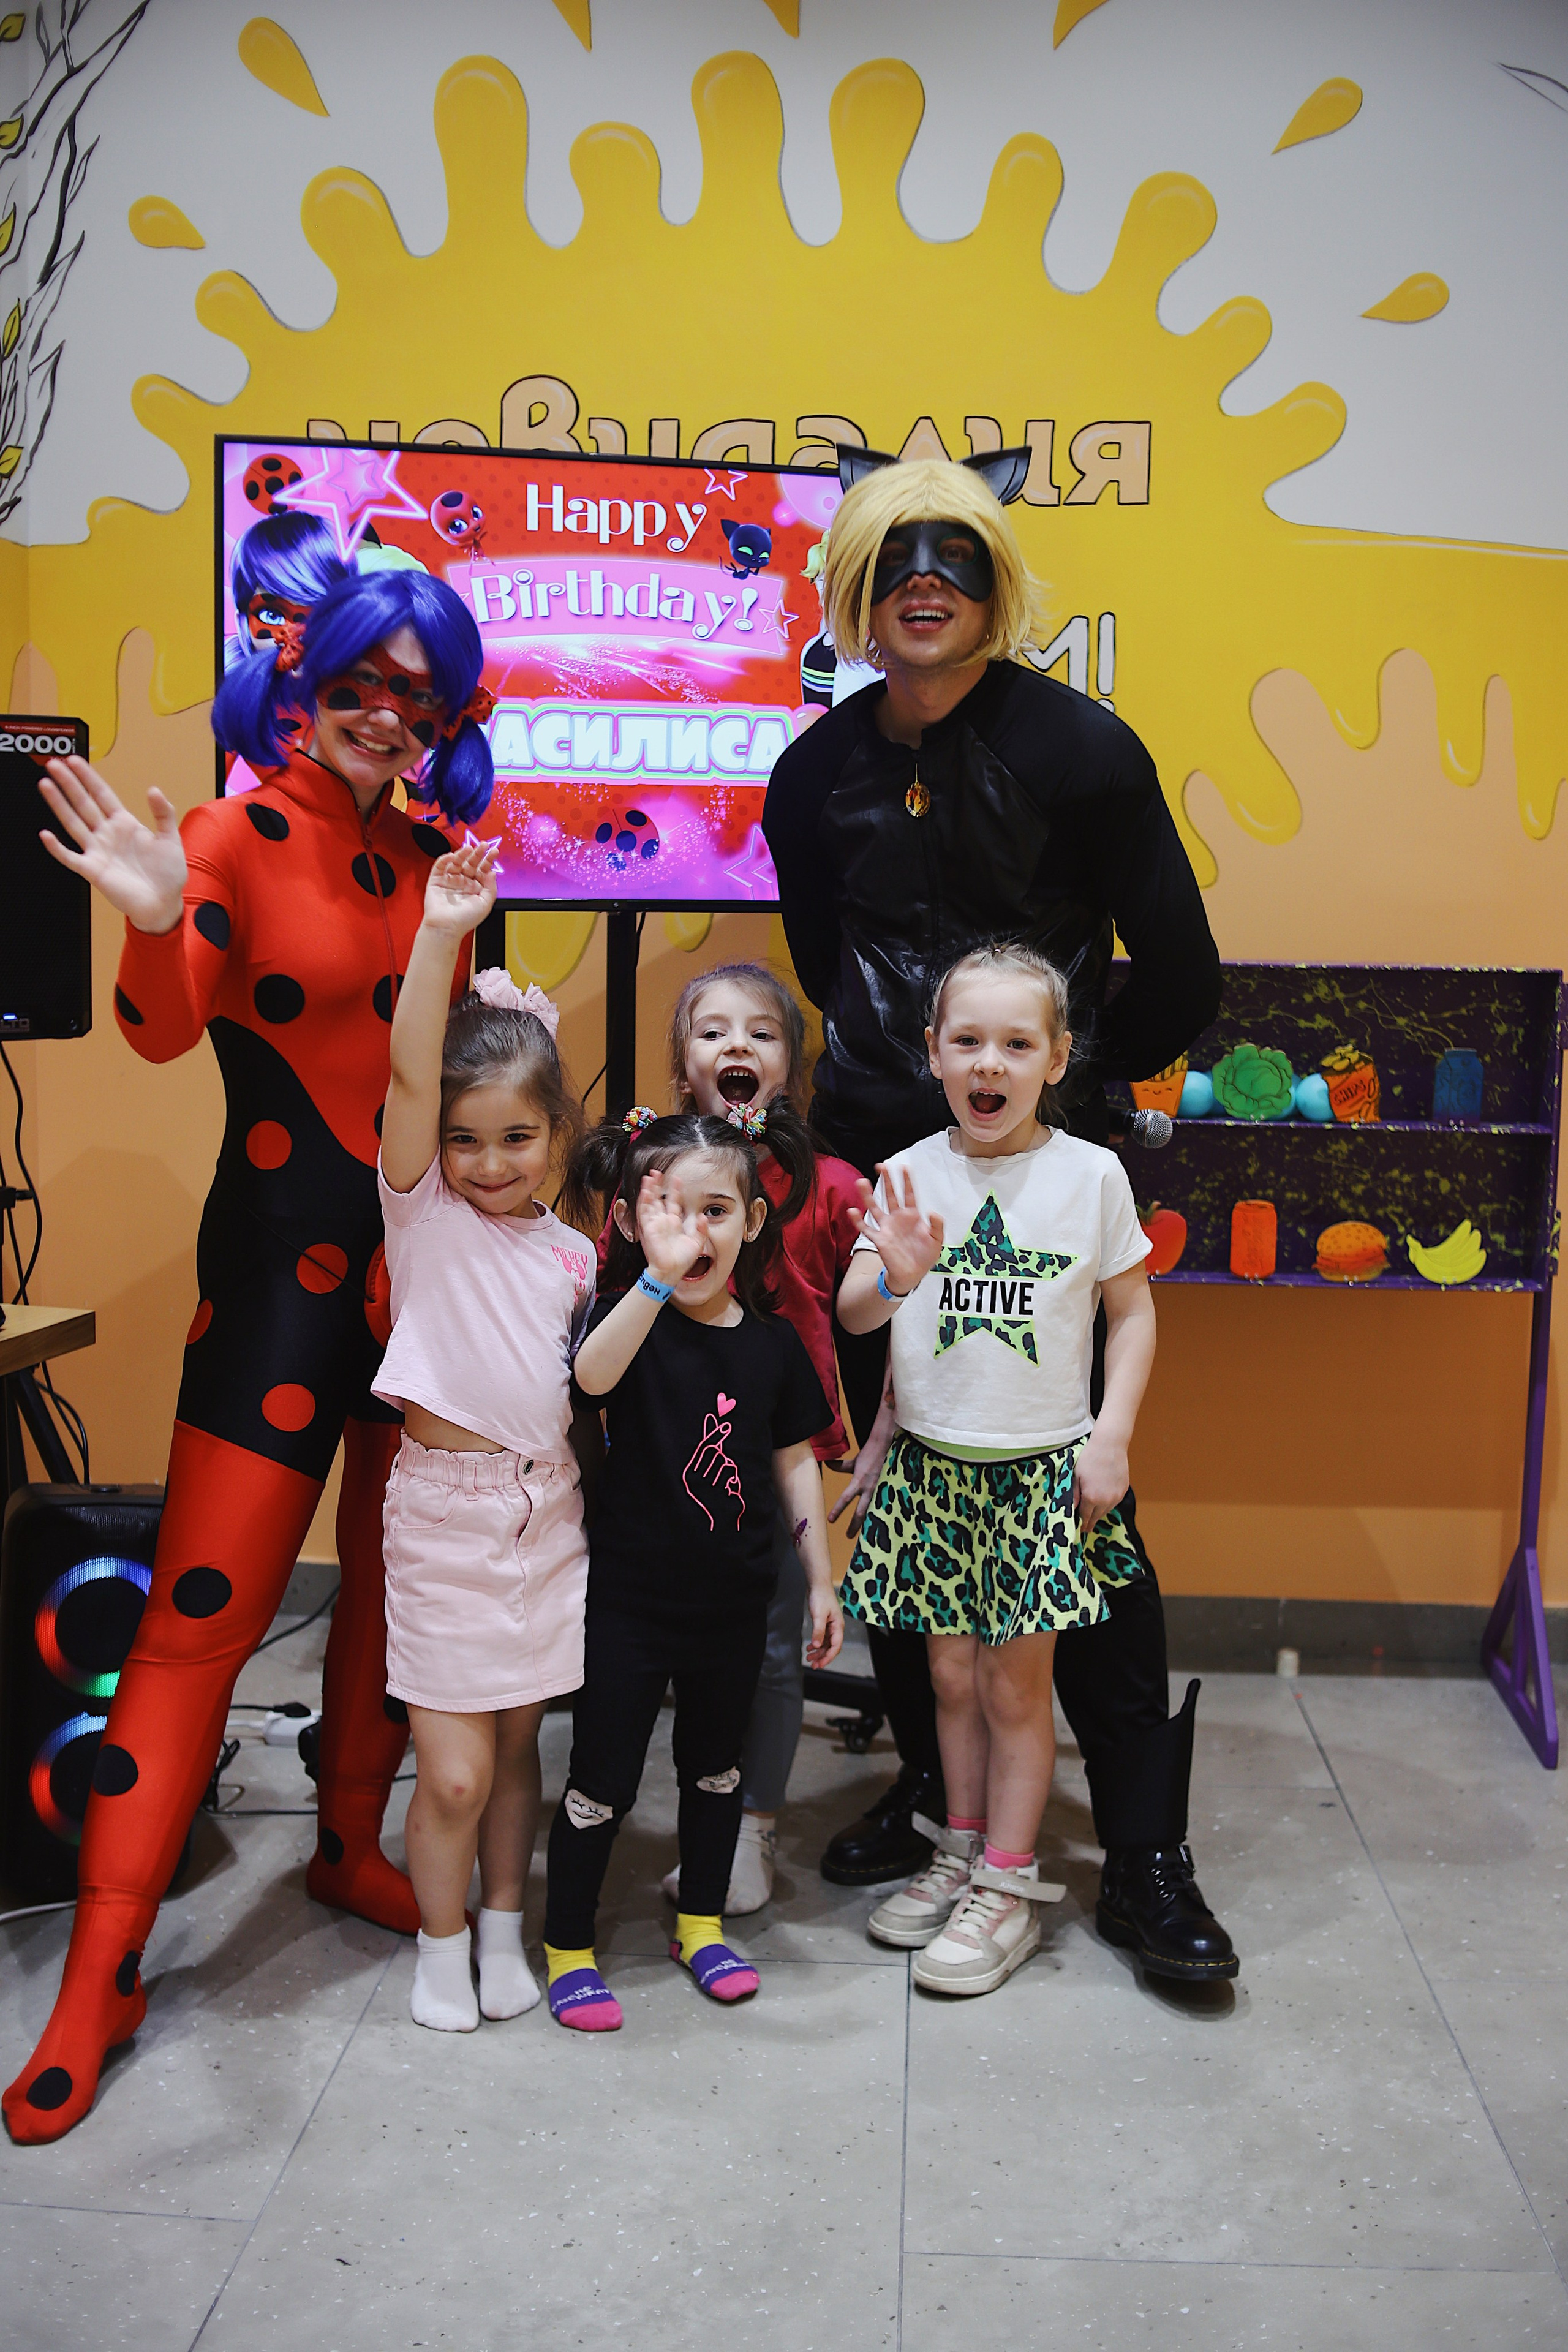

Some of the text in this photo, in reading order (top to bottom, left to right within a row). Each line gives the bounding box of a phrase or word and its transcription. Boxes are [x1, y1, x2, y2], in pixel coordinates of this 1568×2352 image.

[526, 482, 707, 552] Happy
[470, 568, 759, 639] Birthday!
[0, 733, 72, 755] 2000
[480, 710, 789, 773] АСИЛИСА
[938, 1277, 1035, 1316] ACTIVE
